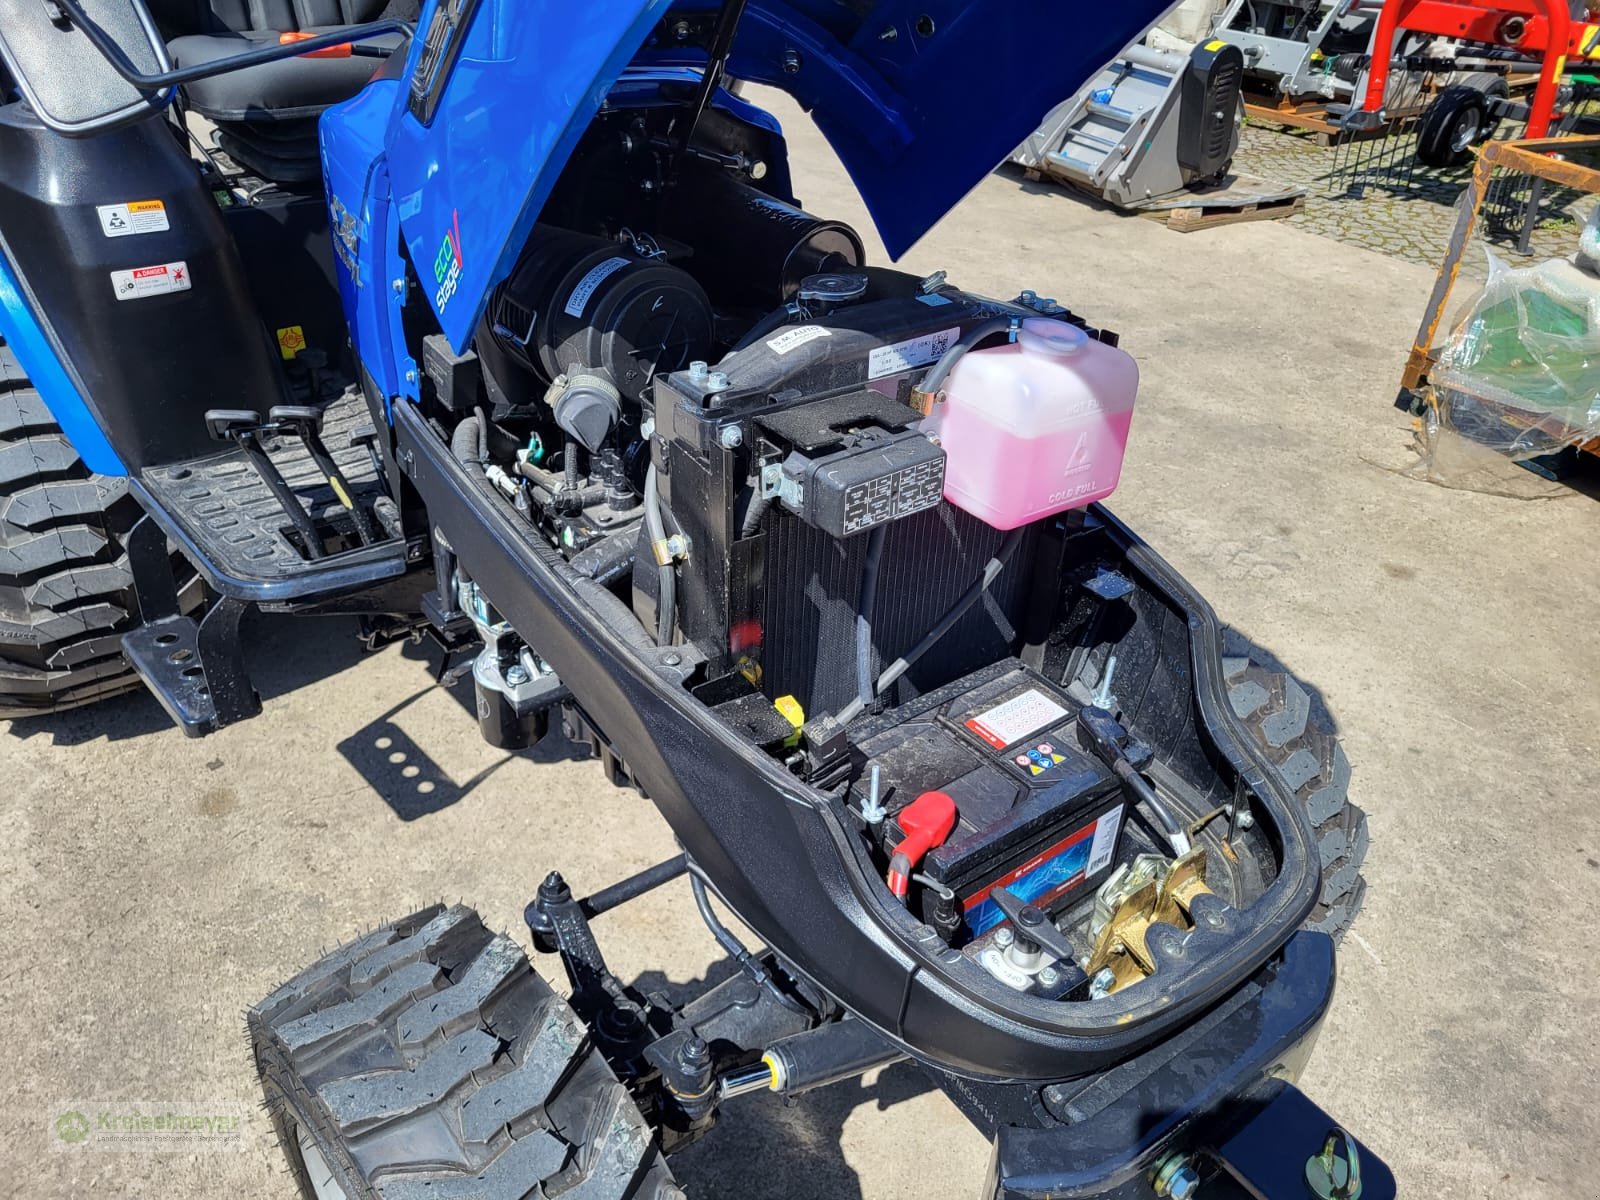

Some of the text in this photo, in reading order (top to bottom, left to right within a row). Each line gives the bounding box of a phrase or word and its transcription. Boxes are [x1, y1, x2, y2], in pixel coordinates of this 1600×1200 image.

[137, 203, 161, 211] WARNING
[142, 267, 165, 277] DANGER
[1048, 480, 1097, 504] COLD FULL
